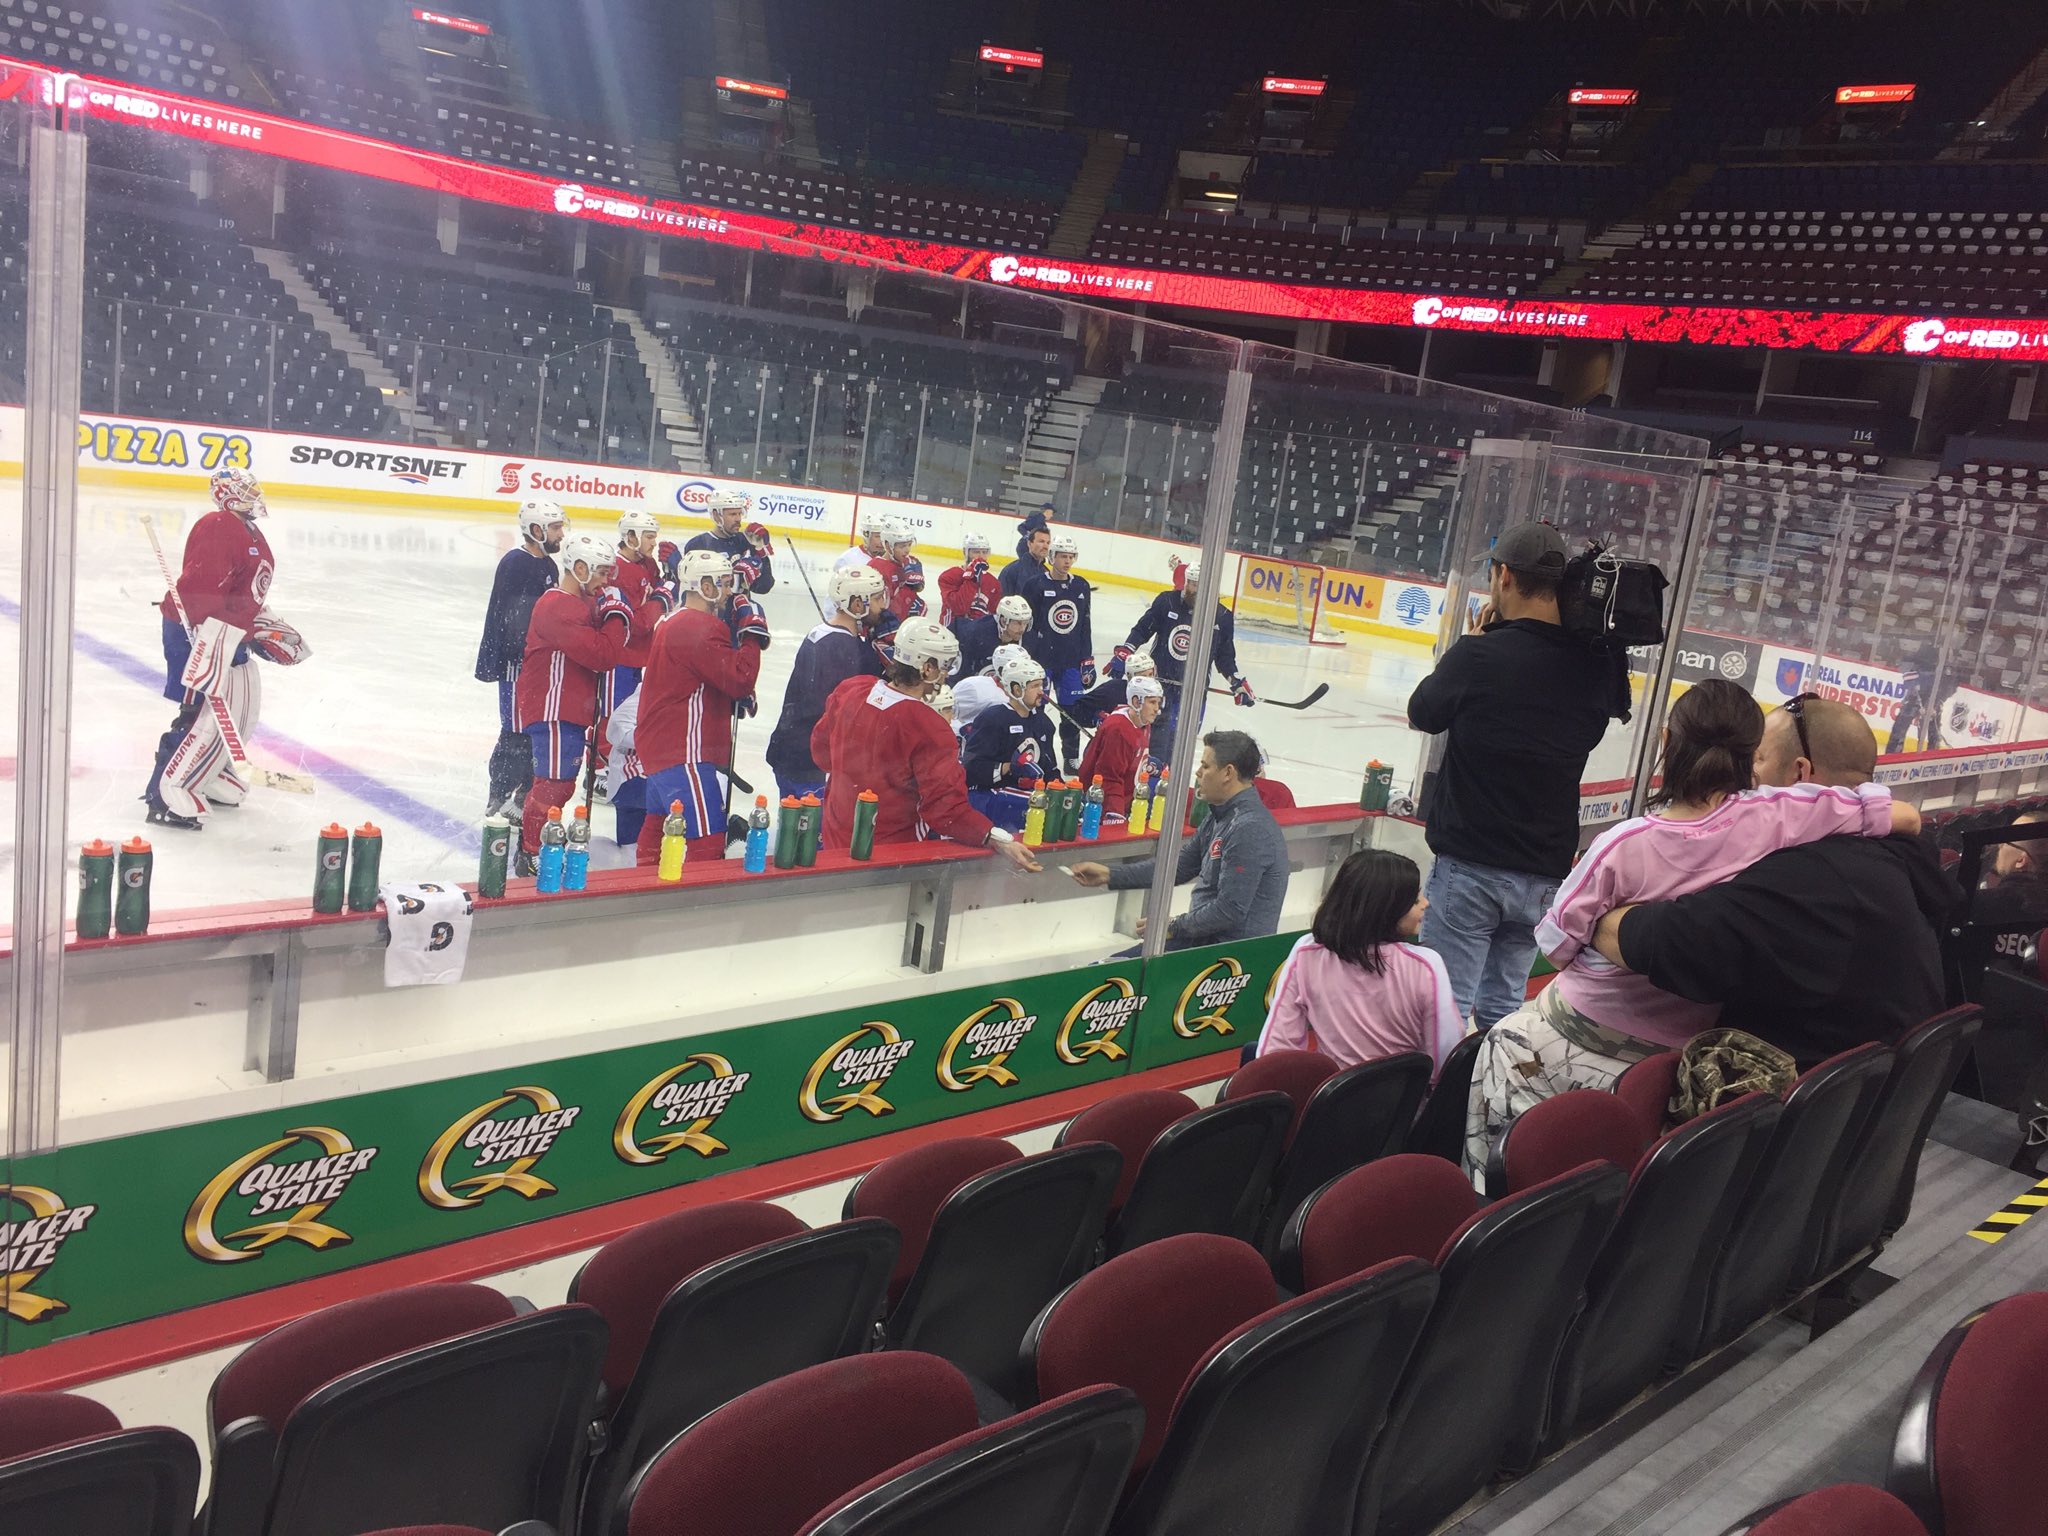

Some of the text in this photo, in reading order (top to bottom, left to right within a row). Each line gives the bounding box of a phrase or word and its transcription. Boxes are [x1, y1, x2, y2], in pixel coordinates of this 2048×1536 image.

[113, 95, 160, 118] RED
[161, 107, 212, 129] LIVES
[216, 119, 263, 140] HERE
[218, 217, 235, 230] 119
[584, 198, 603, 211] OF
[602, 203, 640, 219] RED
[641, 209, 684, 227] LIVES
[687, 217, 728, 233] HERE
[576, 280, 591, 292] 118
[1018, 267, 1037, 280] OF
[1035, 267, 1072, 283] RED
[1072, 273, 1113, 287] LIVES
[1115, 278, 1153, 292] HERE
[1441, 306, 1461, 319] OF
[1460, 306, 1498, 323] RED
[1499, 310, 1544, 325] LIVES
[1546, 312, 1588, 326] HERE
[1943, 330, 1971, 344] OF
[1968, 330, 2019, 348] RED
[78, 420, 252, 470] PIZZA 73
[1853, 430, 1873, 441] 114
[289, 445, 467, 479] SPORTSNET
[530, 472, 646, 499] Scotiabank
[771, 493, 826, 504] FUEL TECHNOLOGY
[758, 496, 825, 520] Synergy
[1250, 567, 1283, 593] ON
[1308, 577, 1365, 608] RUN
[186, 639, 207, 682] VAUGHN
[1847, 673, 1906, 700] CANAD
[208, 695, 247, 762] ARRIOR
[165, 733, 197, 779] VAUGHN
[180, 744, 207, 782] VAUGHN
[1581, 803, 1591, 821] IT
[1590, 801, 1611, 820] FRESH
[490, 838, 507, 856] G
[322, 851, 341, 871] G
[124, 867, 144, 888] G
[1995, 933, 2030, 958] SEC
[1196, 973, 1252, 997] QUAKER
[1081, 995, 1149, 1020] QUAKER
[1199, 989, 1240, 1011] STATE
[965, 1015, 1038, 1044] QUAKER
[1085, 1011, 1132, 1035] STATE
[832, 1039, 915, 1072] QUAKER
[970, 1033, 1024, 1059] STATE
[838, 1059, 899, 1088] STATE
[652, 1072, 750, 1109] QUAKER
[659, 1094, 733, 1126] STATE
[464, 1106, 581, 1148] QUAKER
[473, 1130, 560, 1167] STATE
[238, 1147, 377, 1196] QUAKER
[250, 1174, 353, 1216] STATE
